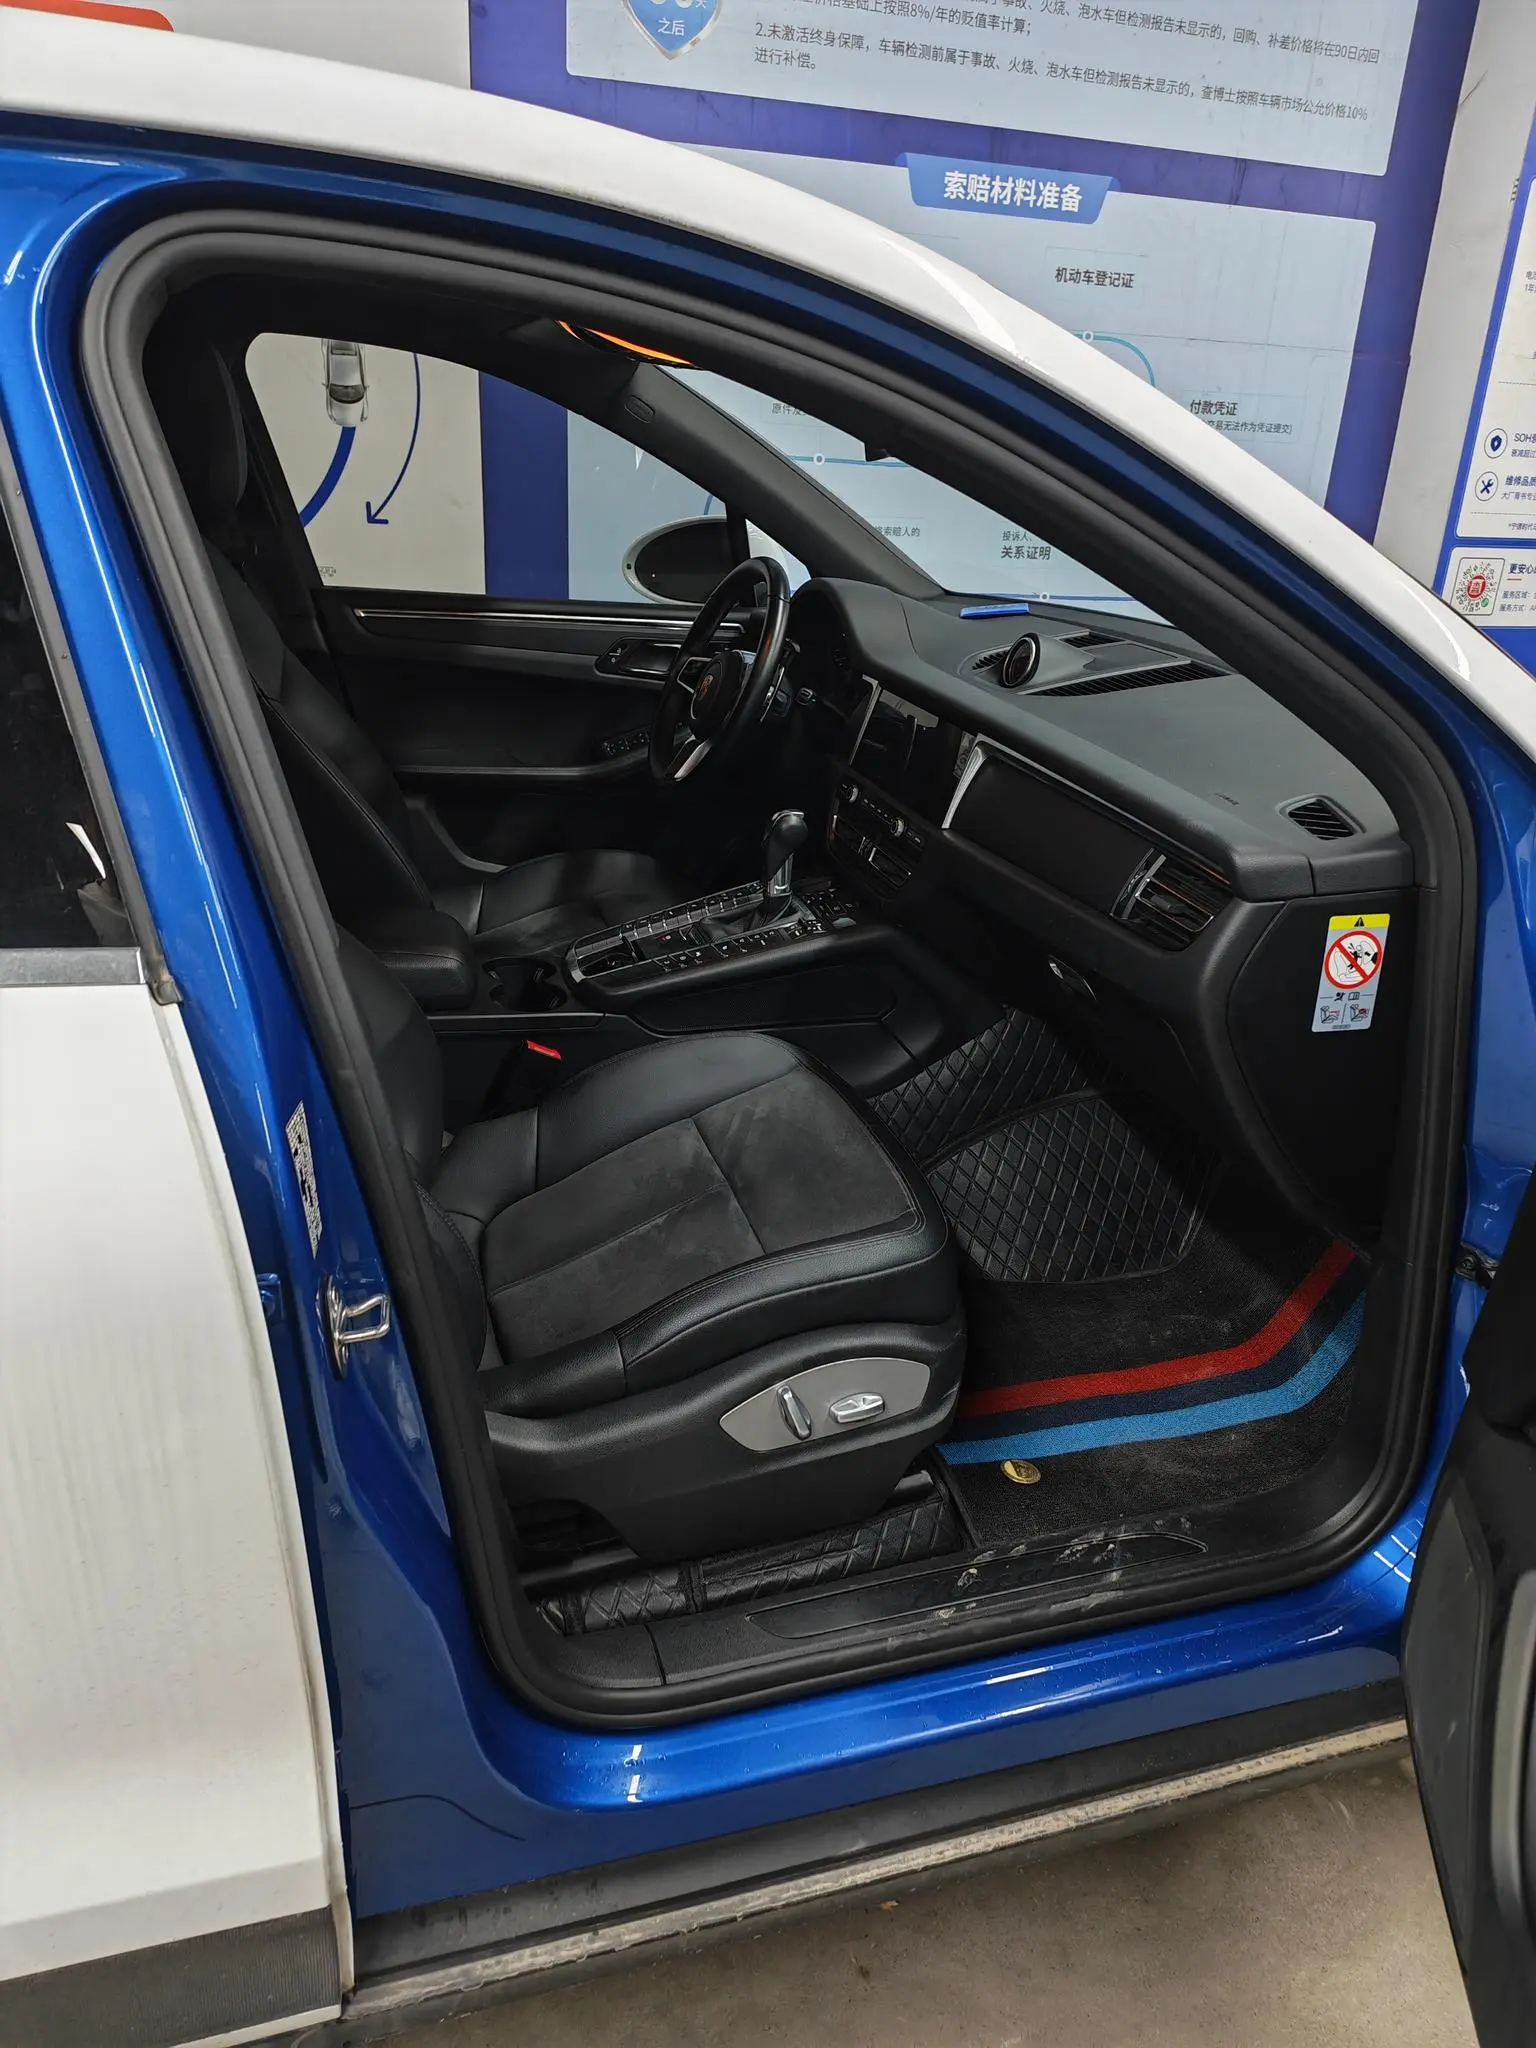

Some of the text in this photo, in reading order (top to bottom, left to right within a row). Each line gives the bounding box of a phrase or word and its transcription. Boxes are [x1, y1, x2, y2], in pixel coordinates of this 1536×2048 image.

[658, 16, 685, 36] 之后
[966, 0, 1379, 63] 事故、火烧、泡水车但检测报告未显示的，回购、补差价格将在90日内回
[754, 46, 816, 70] 进行补偿。
[943, 170, 1082, 212] 索赔材料准备
[1055, 266, 1135, 288] 机动车登记证
[1190, 399, 1239, 416] 付款凭证
[1001, 545, 1051, 560] 关系证明
[1508, 563, 1536, 574] 更安心
